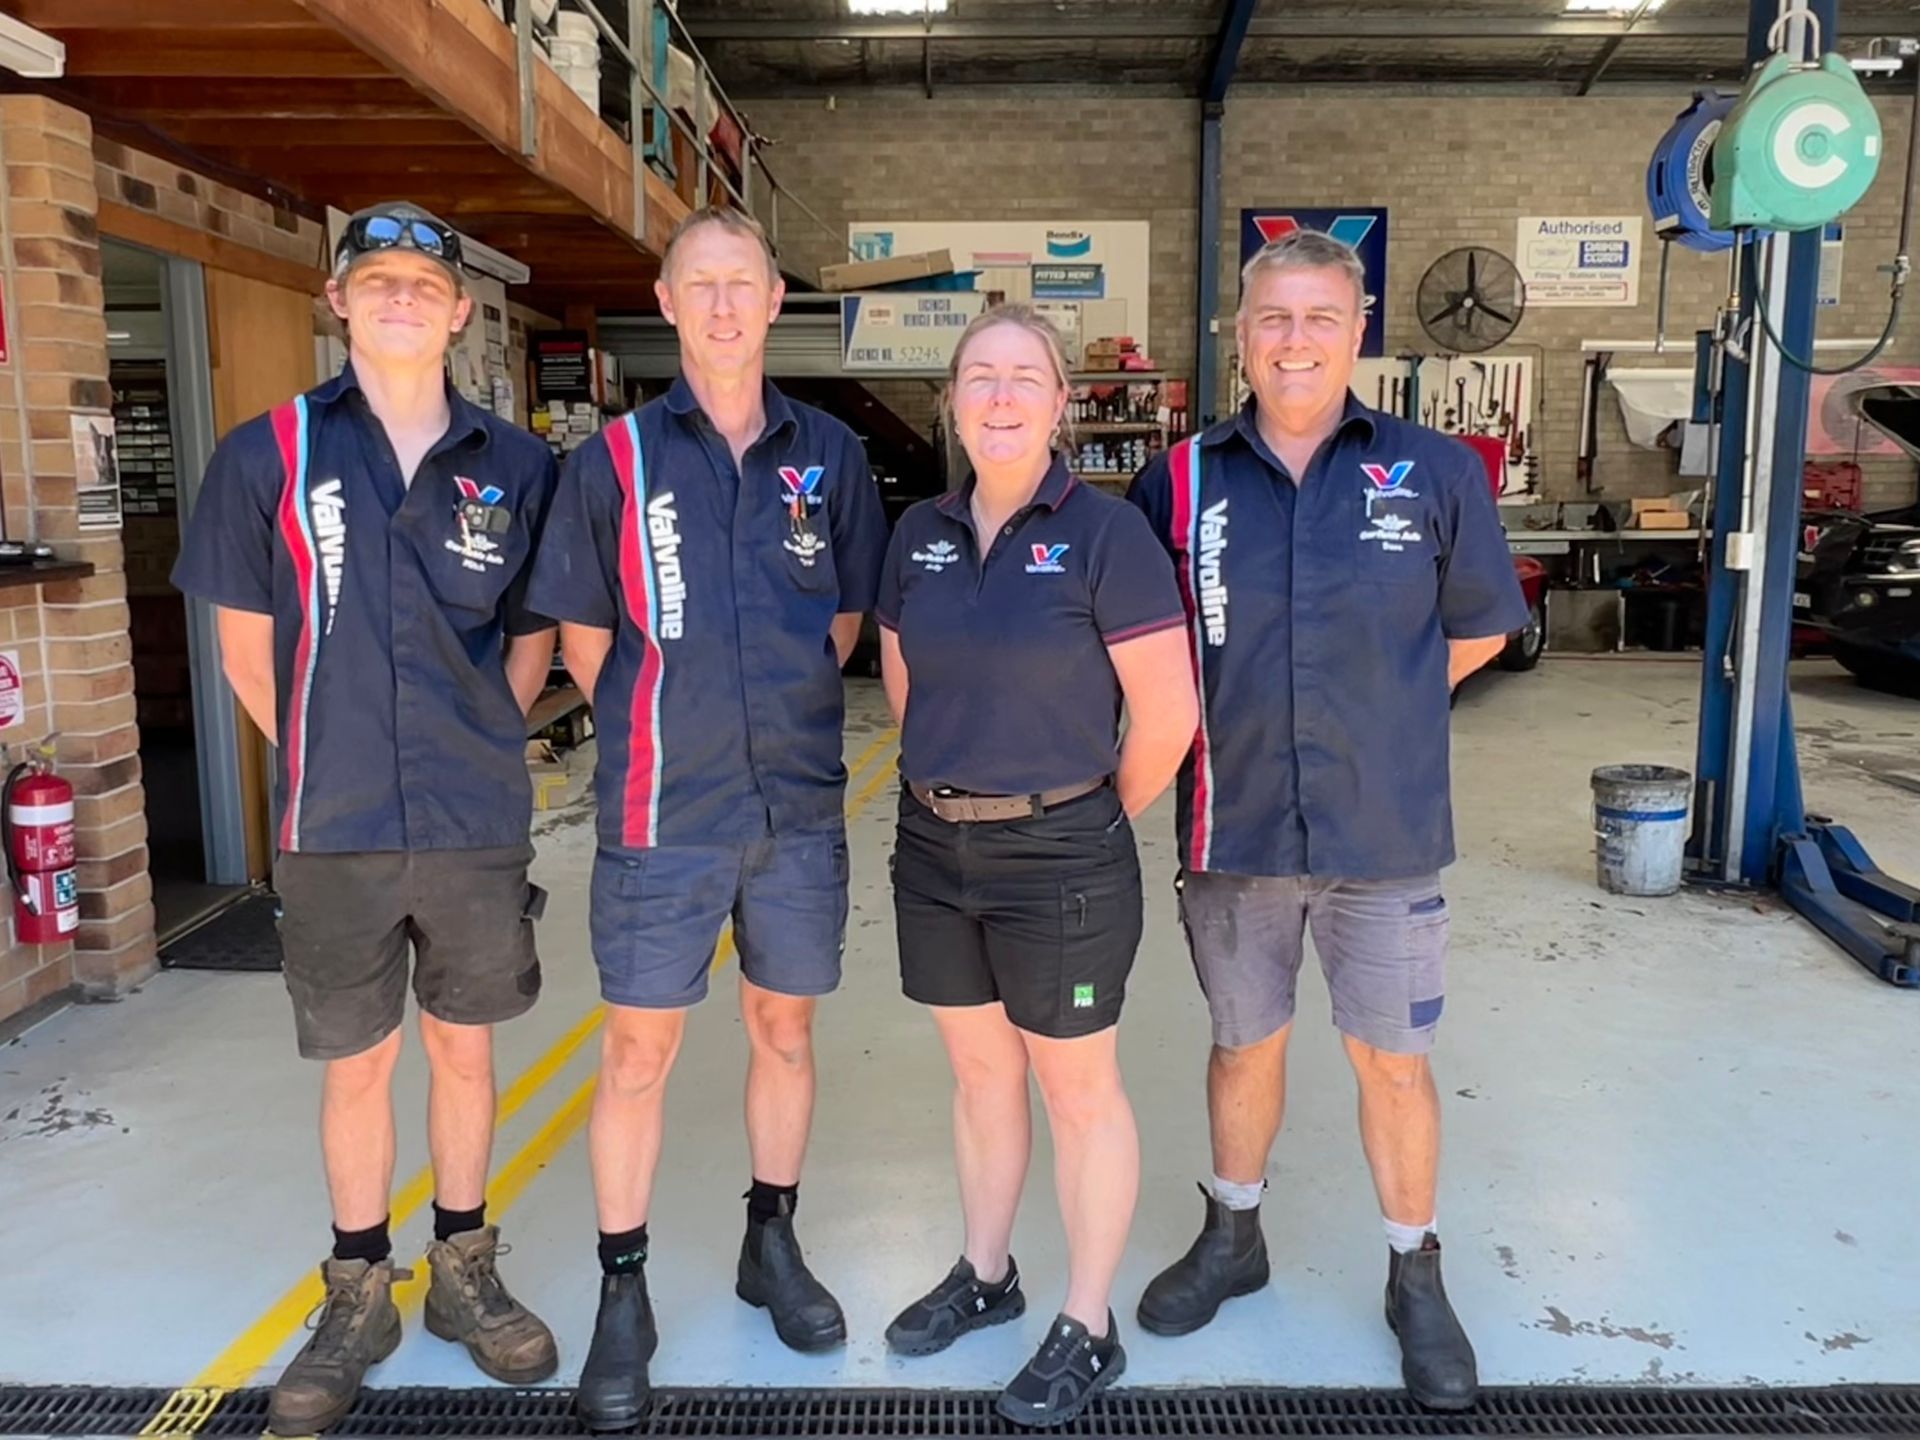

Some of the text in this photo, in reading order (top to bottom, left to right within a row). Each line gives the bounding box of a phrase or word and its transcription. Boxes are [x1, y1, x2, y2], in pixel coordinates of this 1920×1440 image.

[1045, 230, 1084, 240] Bendix
[1537, 220, 1623, 235] Authorised
[1034, 270, 1096, 280] FITTED HERE!
[903, 313, 930, 326] VEHICLE
[934, 313, 967, 326] REPAIRER
[851, 348, 879, 361] LICENCE
[900, 346, 941, 361] 52245
[647, 491, 687, 639] Valvoline
[1199, 498, 1228, 647] Valvoline
